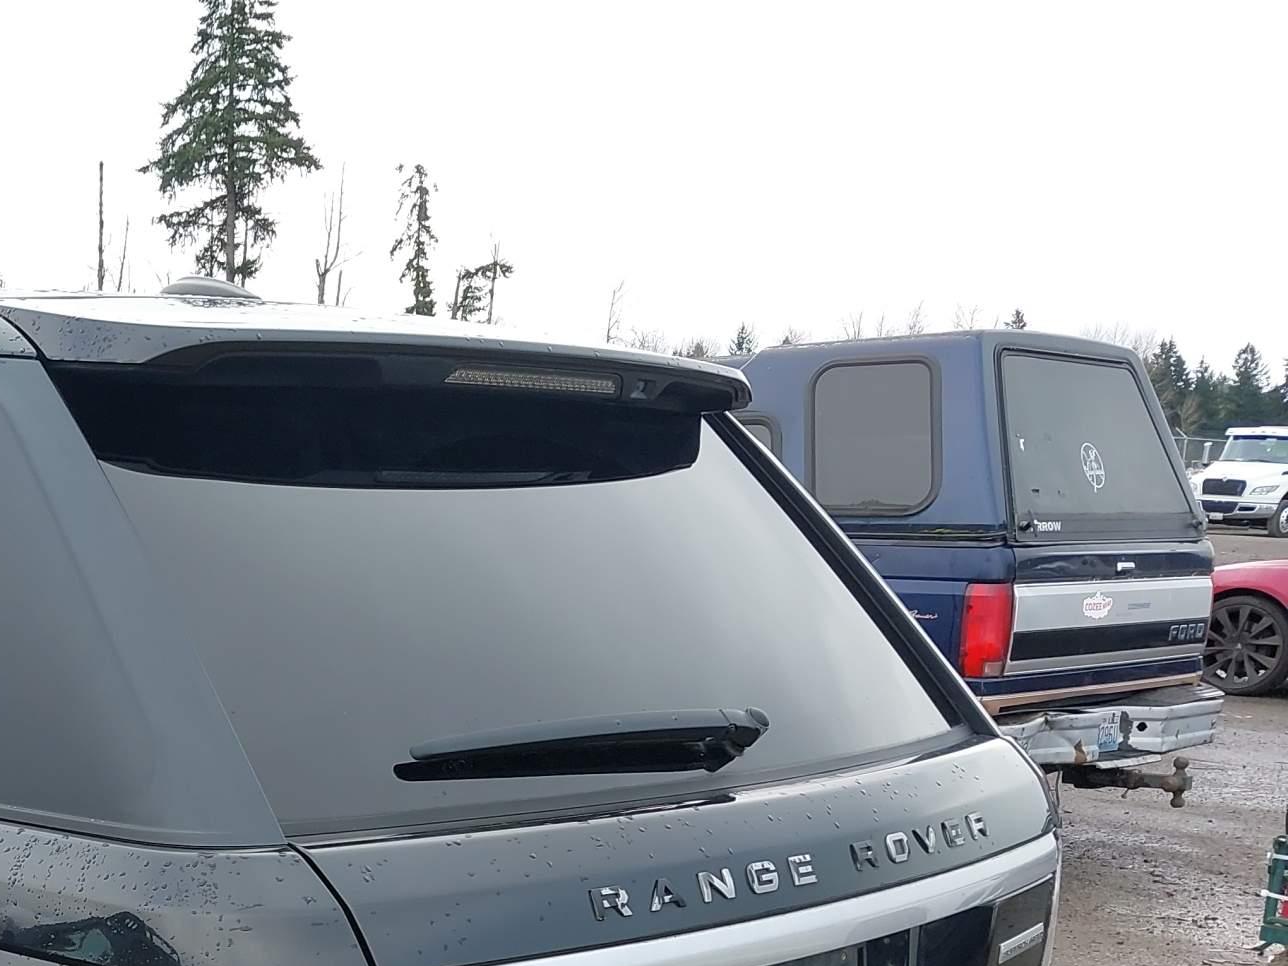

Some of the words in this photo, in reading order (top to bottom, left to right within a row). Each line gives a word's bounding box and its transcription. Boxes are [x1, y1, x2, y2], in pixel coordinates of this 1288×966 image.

[1168, 623, 1205, 641] FORD
[589, 854, 818, 921] RANGE
[850, 810, 991, 872] ROVER
